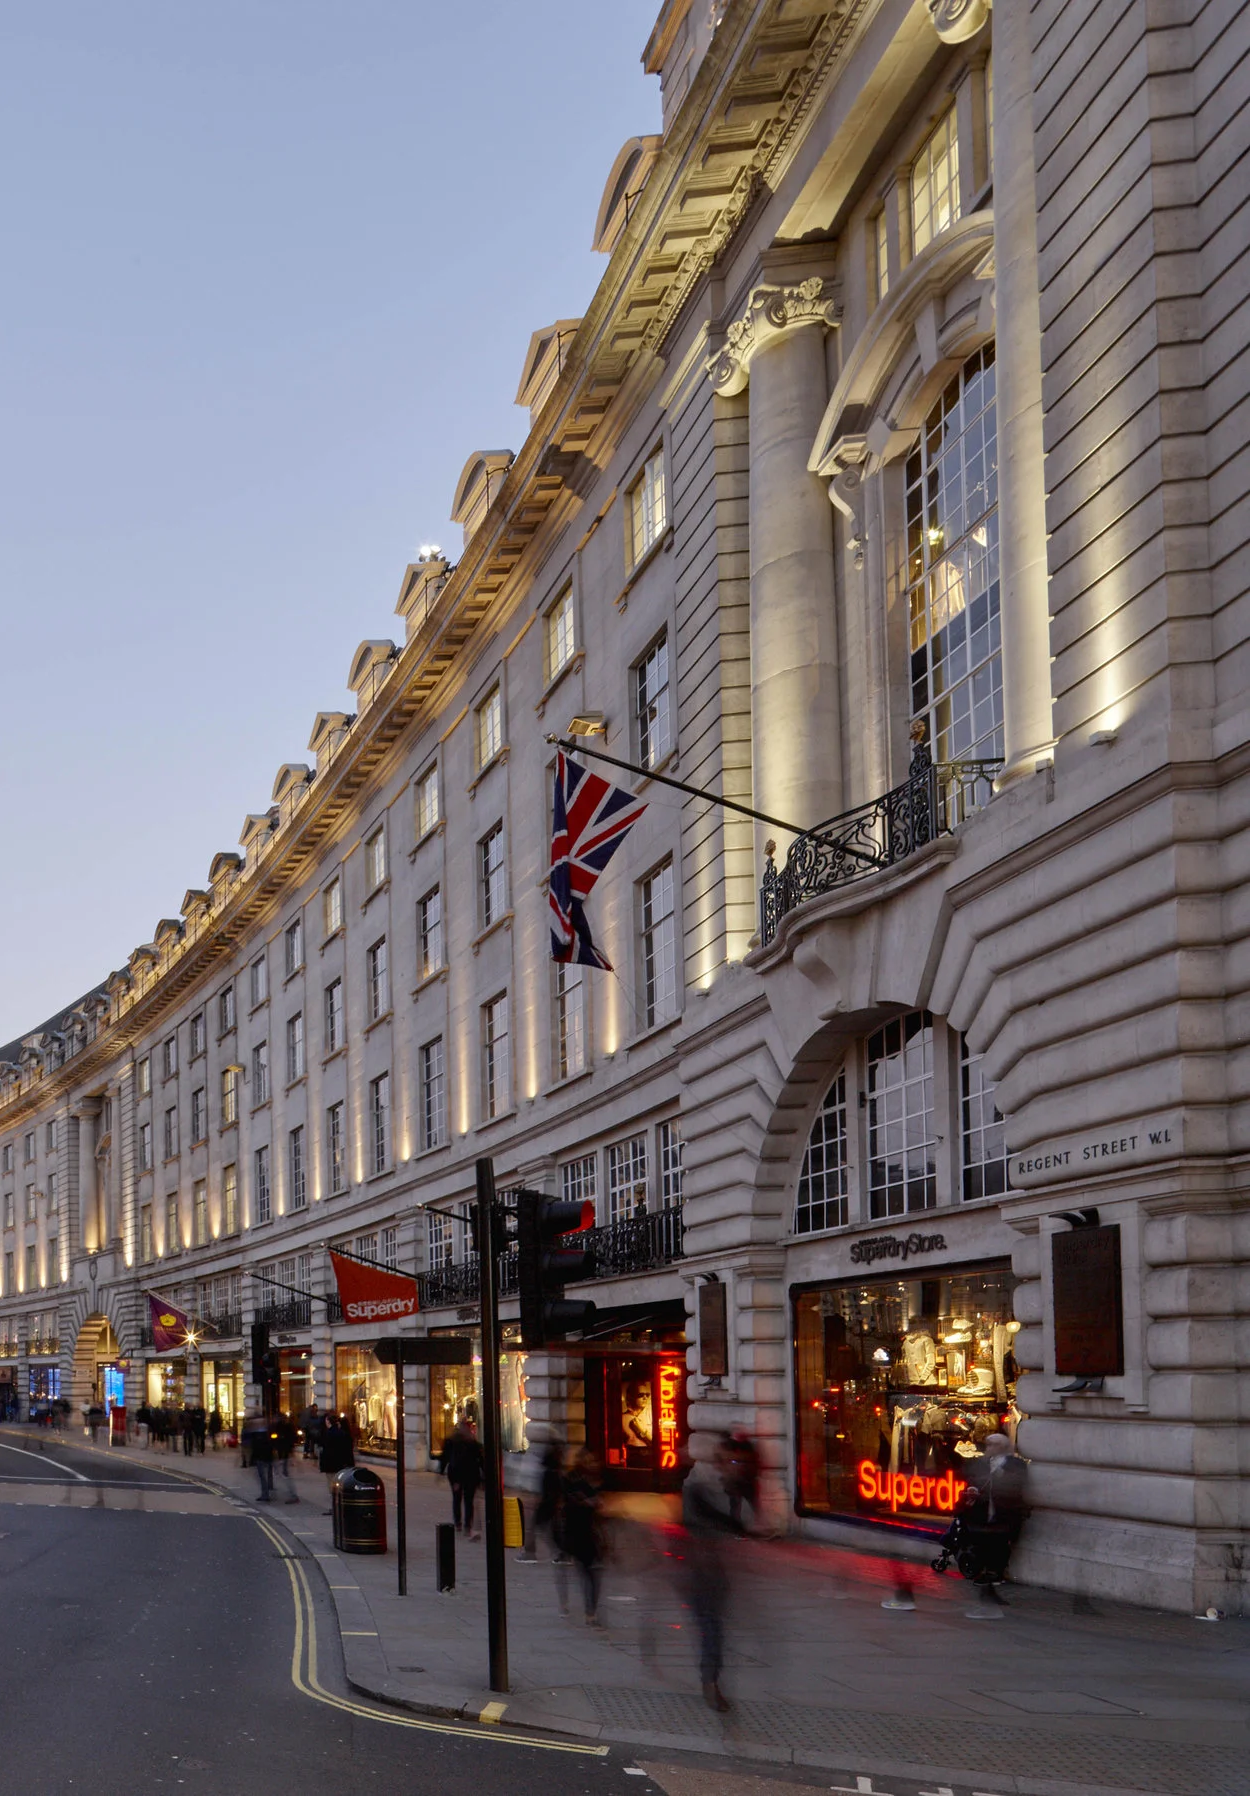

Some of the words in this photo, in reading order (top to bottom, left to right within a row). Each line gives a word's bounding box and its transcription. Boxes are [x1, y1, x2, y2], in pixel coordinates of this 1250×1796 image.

[1018, 1151, 1071, 1175] REGENT
[1083, 1136, 1138, 1160] STREET
[346, 1297, 415, 1320] Superdry
[858, 1459, 968, 1512] Superdr
